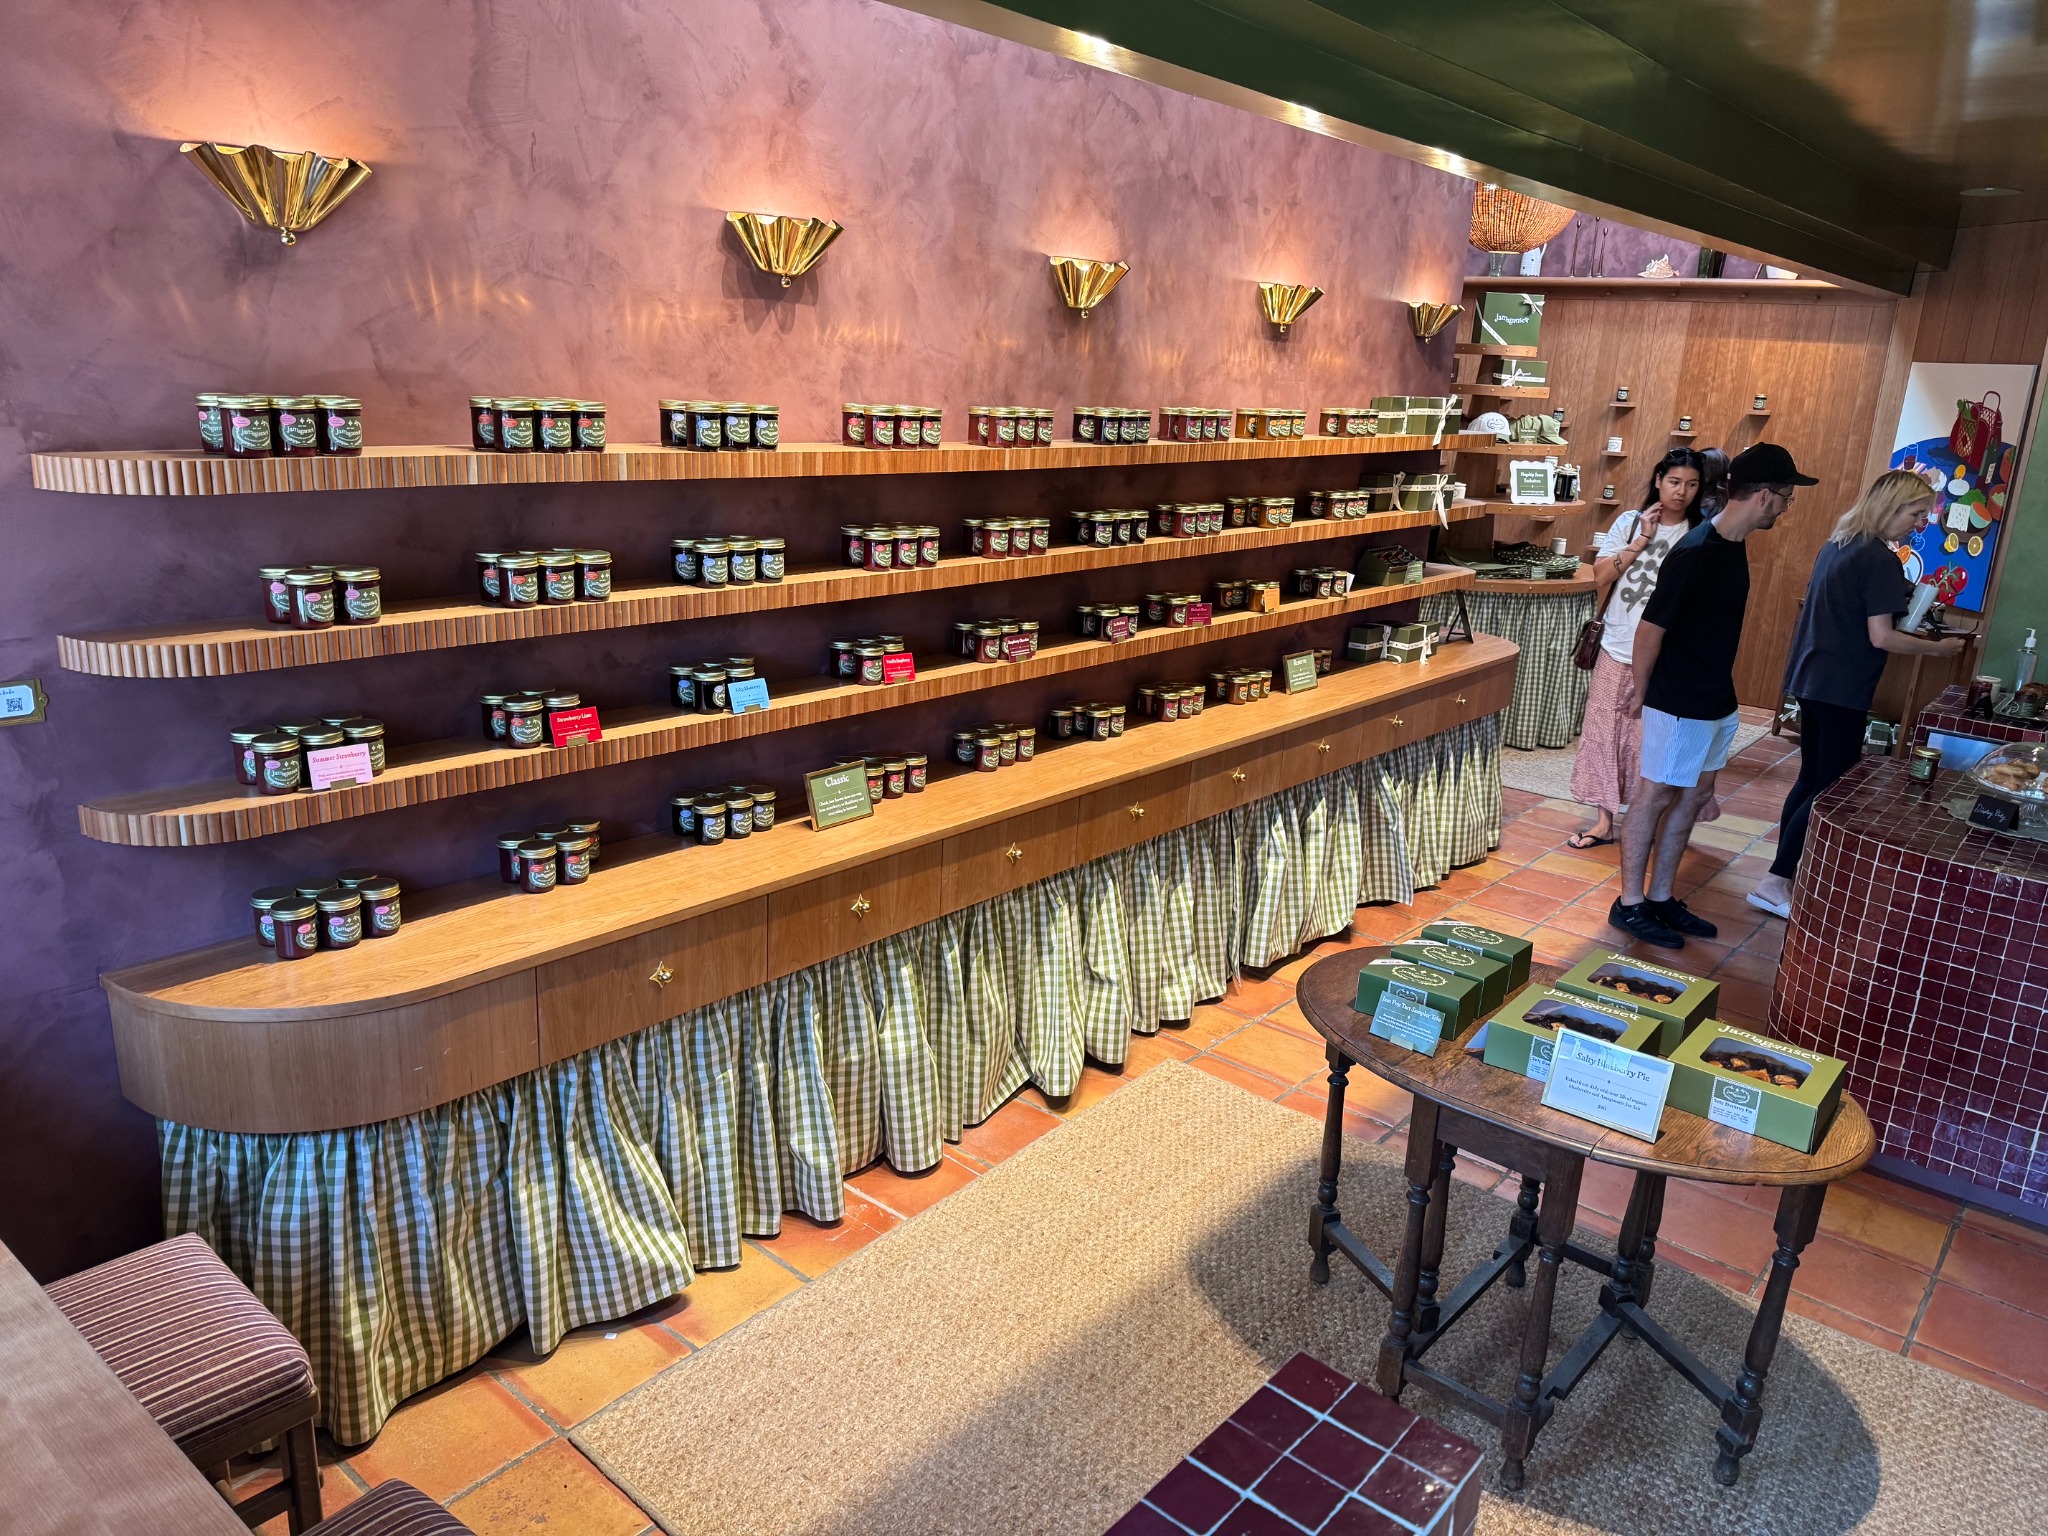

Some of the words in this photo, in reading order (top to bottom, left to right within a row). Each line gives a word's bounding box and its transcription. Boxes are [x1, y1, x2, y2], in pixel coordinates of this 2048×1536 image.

[312, 755, 336, 763] Summer
[336, 750, 367, 761] Strawberry
[825, 774, 850, 788] Classic
[1575, 1052, 1597, 1066] Salty
[1597, 1059, 1636, 1079] Blueberry
[1638, 1071, 1650, 1082] Pie
